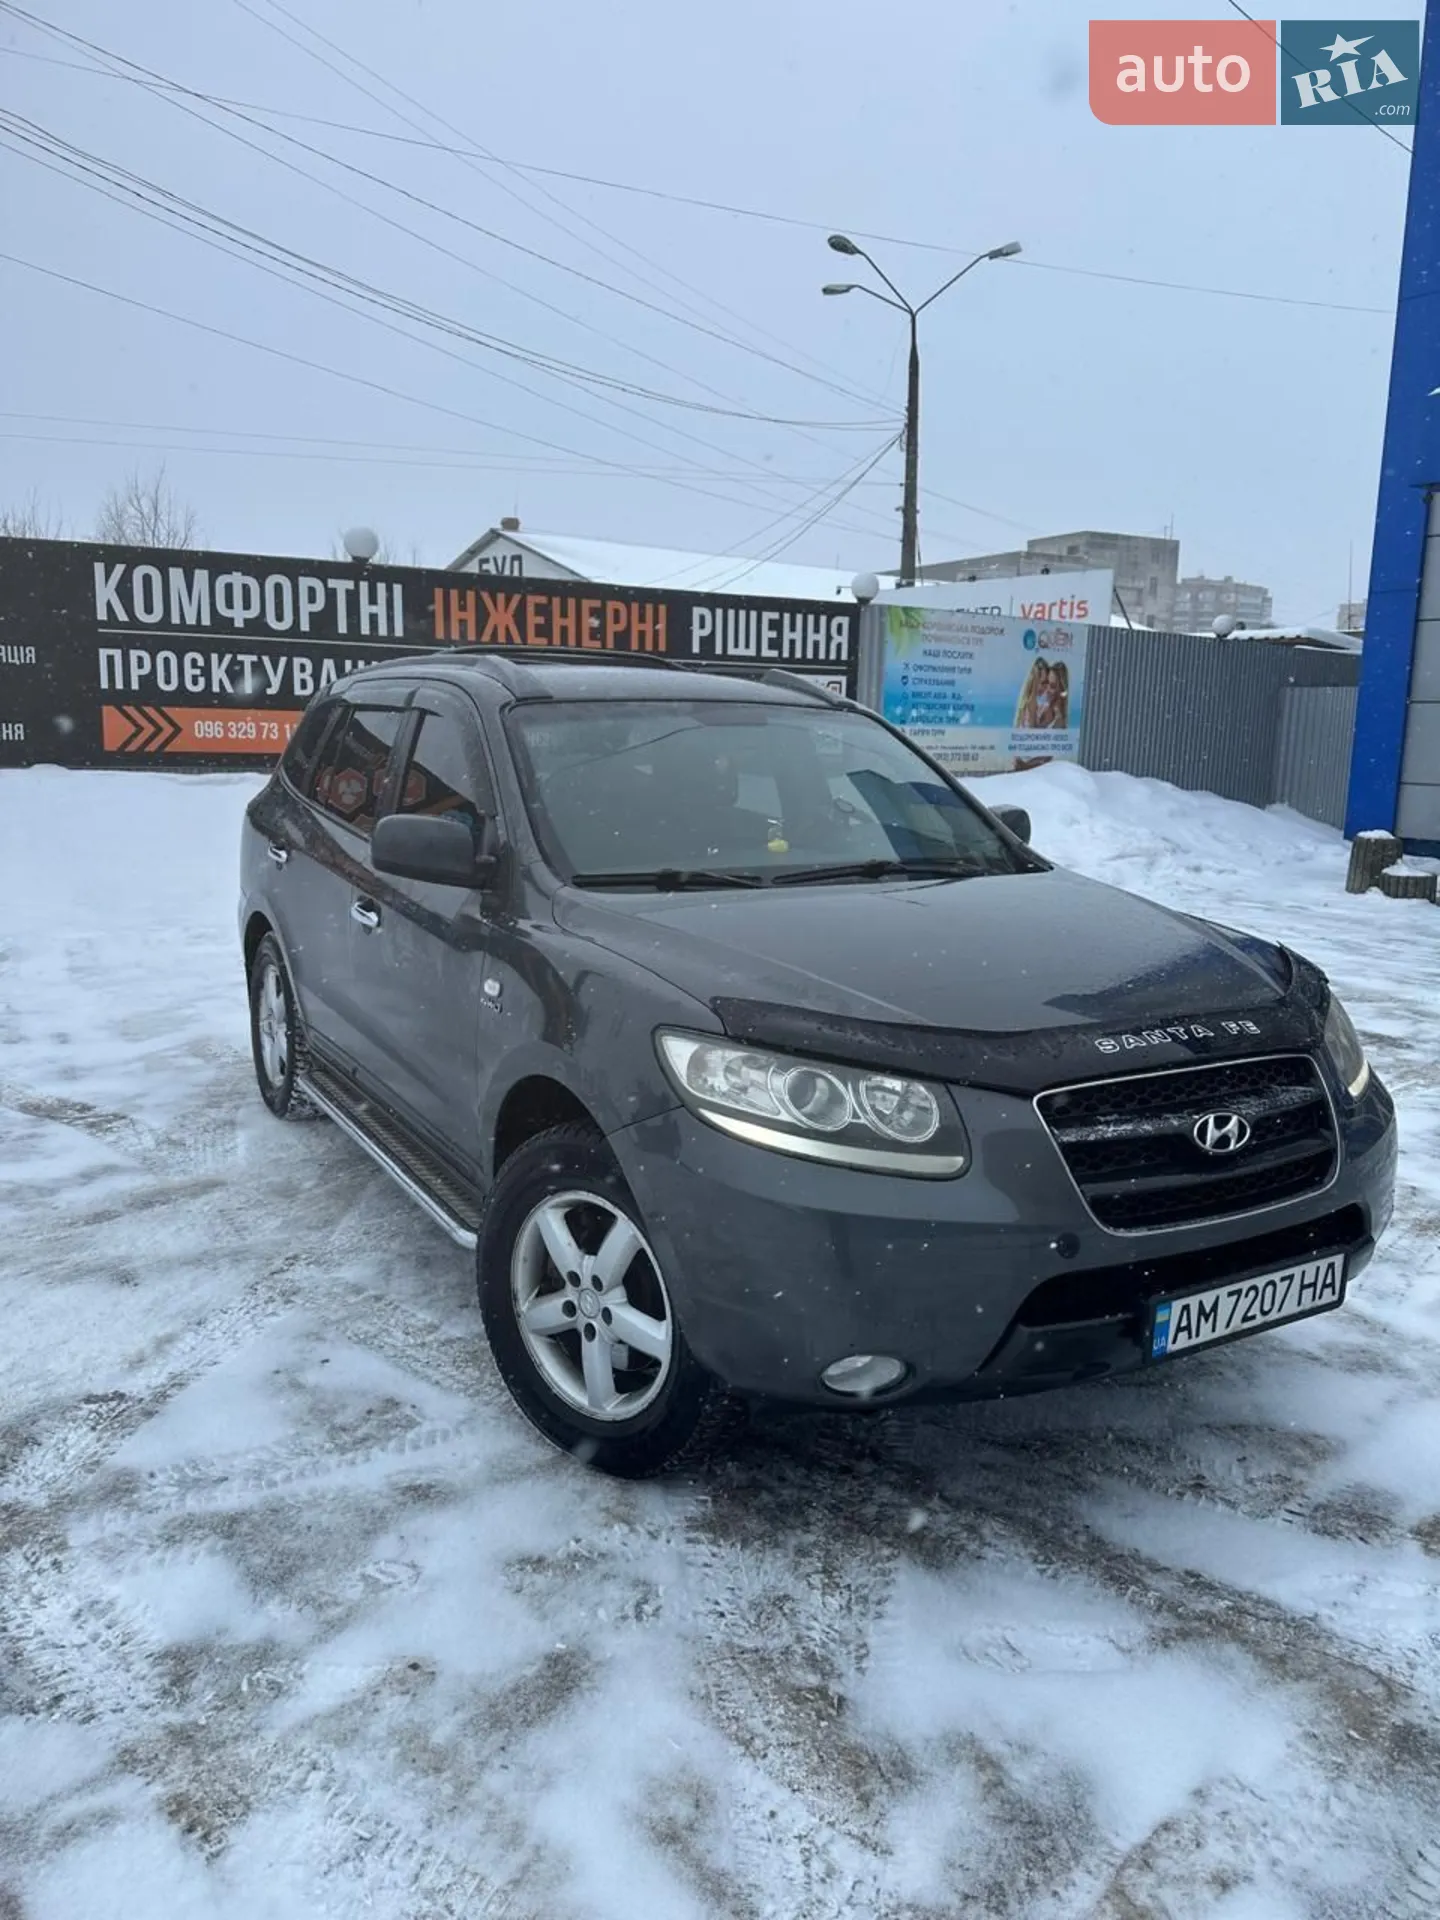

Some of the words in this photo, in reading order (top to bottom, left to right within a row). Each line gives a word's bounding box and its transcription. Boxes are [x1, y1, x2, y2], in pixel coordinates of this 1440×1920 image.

[93, 561, 404, 638] КОМФОРТНІ
[433, 586, 668, 652] ІНЖЕНЕРНІ
[691, 606, 850, 661] РІШЕННЯ
[1020, 595, 1089, 621] vartis
[194, 720, 224, 739] 096
[228, 722, 257, 740] 329
[260, 723, 279, 741] 73
[1095, 1024, 1214, 1054] SANTA
[1222, 1019, 1261, 1034] FE
[1171, 1298, 1222, 1345] AM
[1224, 1276, 1297, 1330] 7207
[1297, 1261, 1337, 1307] HA
